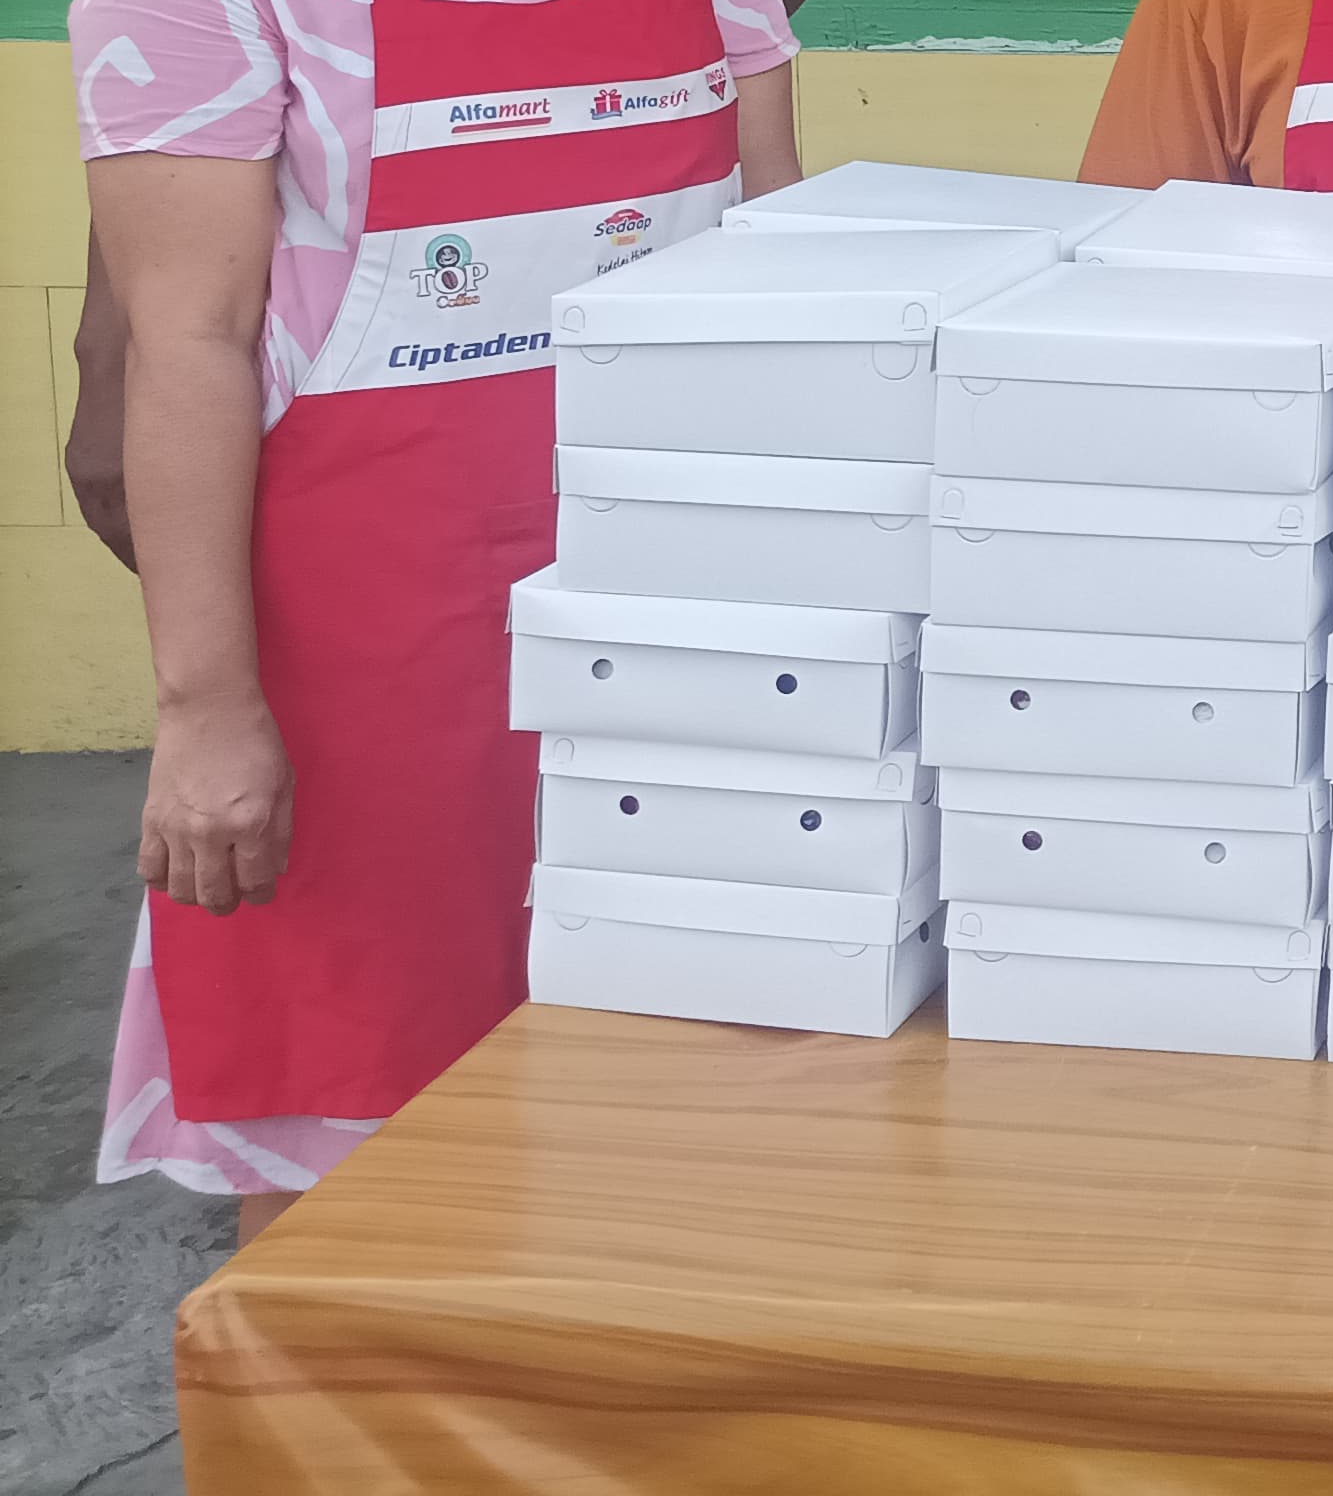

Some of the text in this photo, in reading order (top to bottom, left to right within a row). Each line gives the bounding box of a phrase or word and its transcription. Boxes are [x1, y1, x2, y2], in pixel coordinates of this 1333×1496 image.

[450, 97, 551, 124] Alfamart
[624, 88, 691, 111] Alfagift
[594, 216, 652, 237] Sedaap
[410, 263, 488, 297] TOP
[389, 331, 550, 371] Ciptaden
